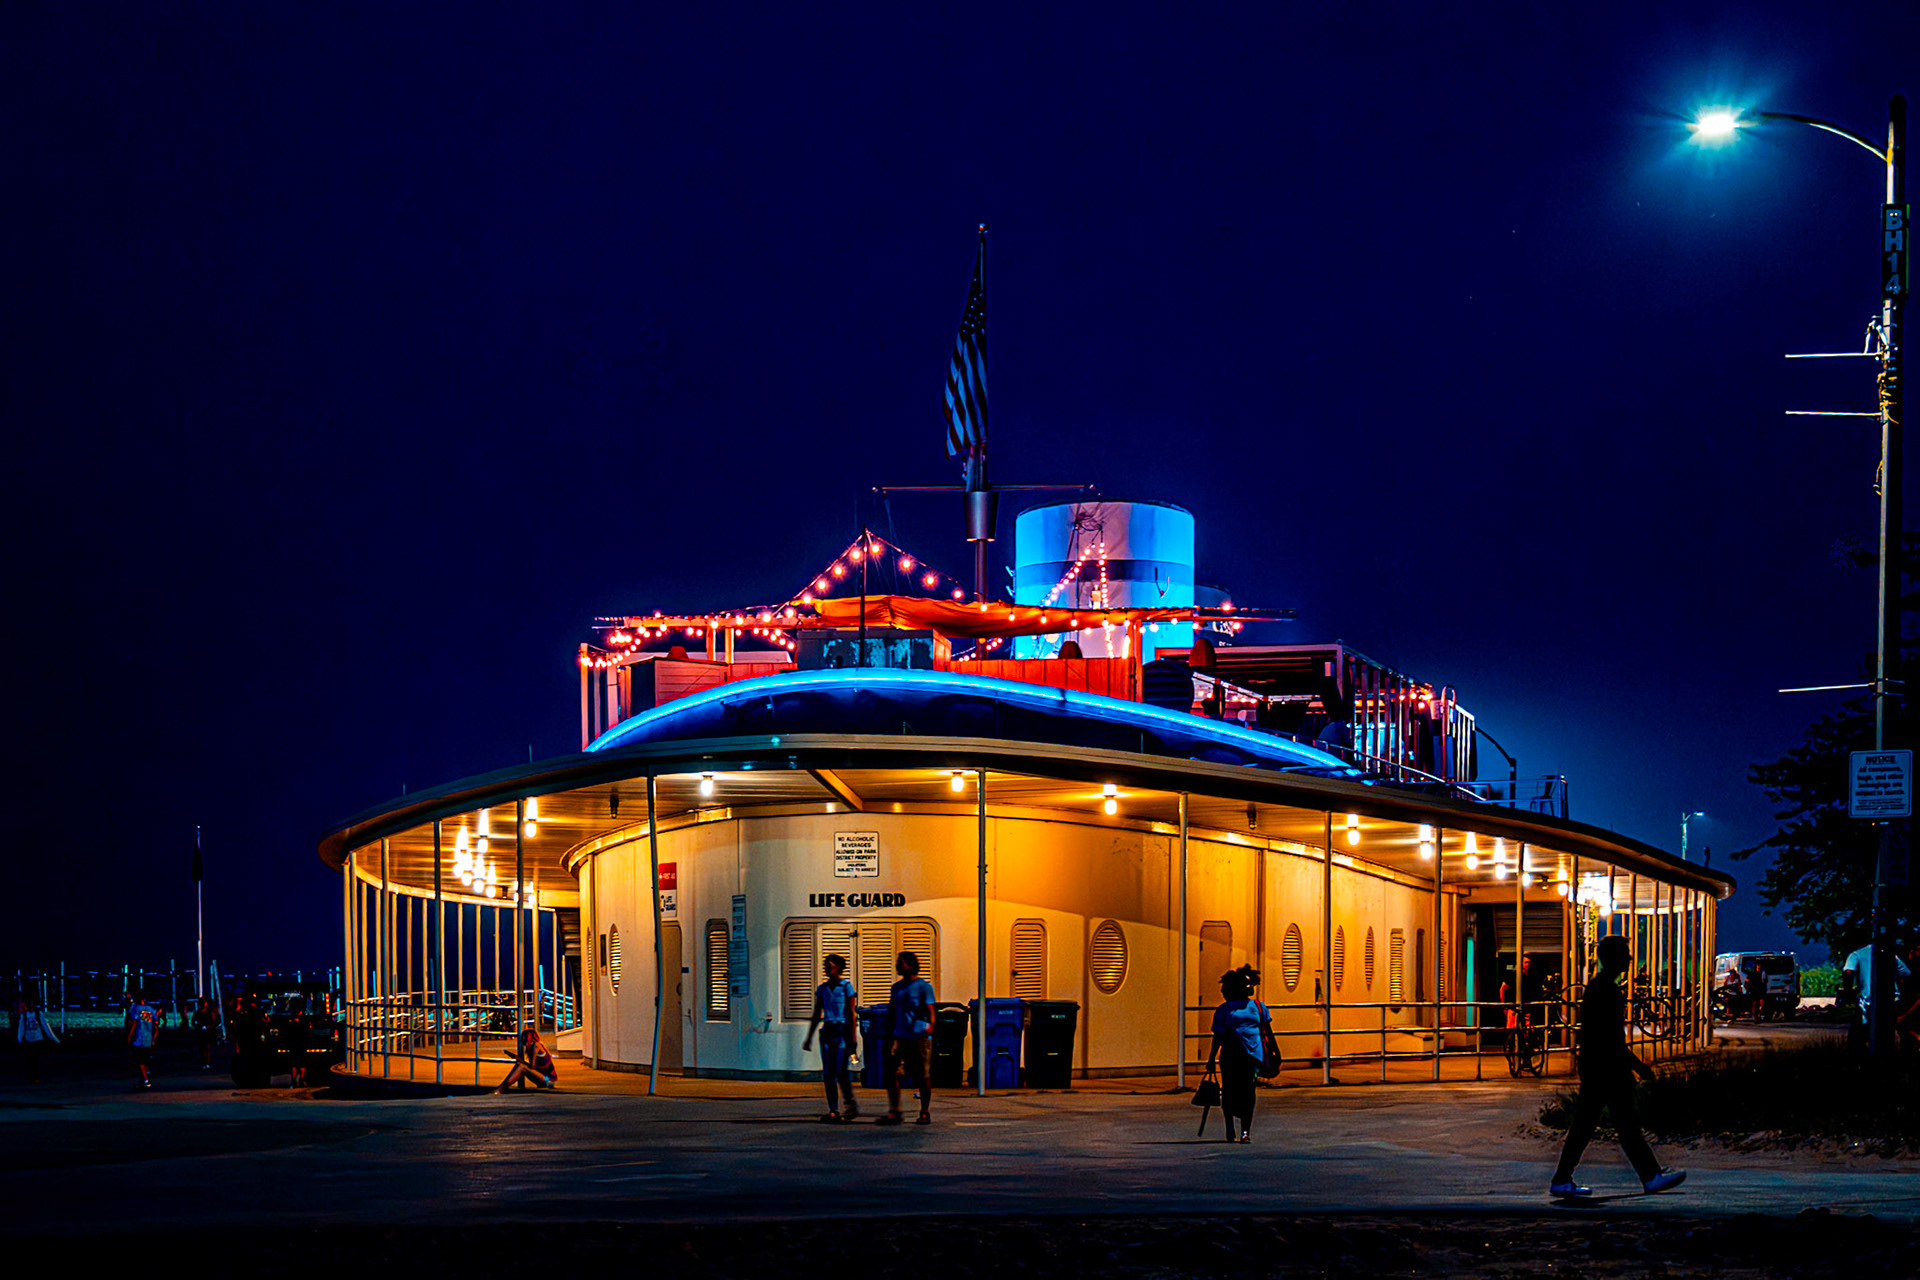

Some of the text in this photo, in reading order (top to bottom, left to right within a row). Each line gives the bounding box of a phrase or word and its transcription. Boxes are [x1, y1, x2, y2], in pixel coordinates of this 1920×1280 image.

[1884, 209, 1903, 294] BH14
[1866, 755, 1896, 763] NOTICE
[809, 893, 906, 907] LIFE GUARD
